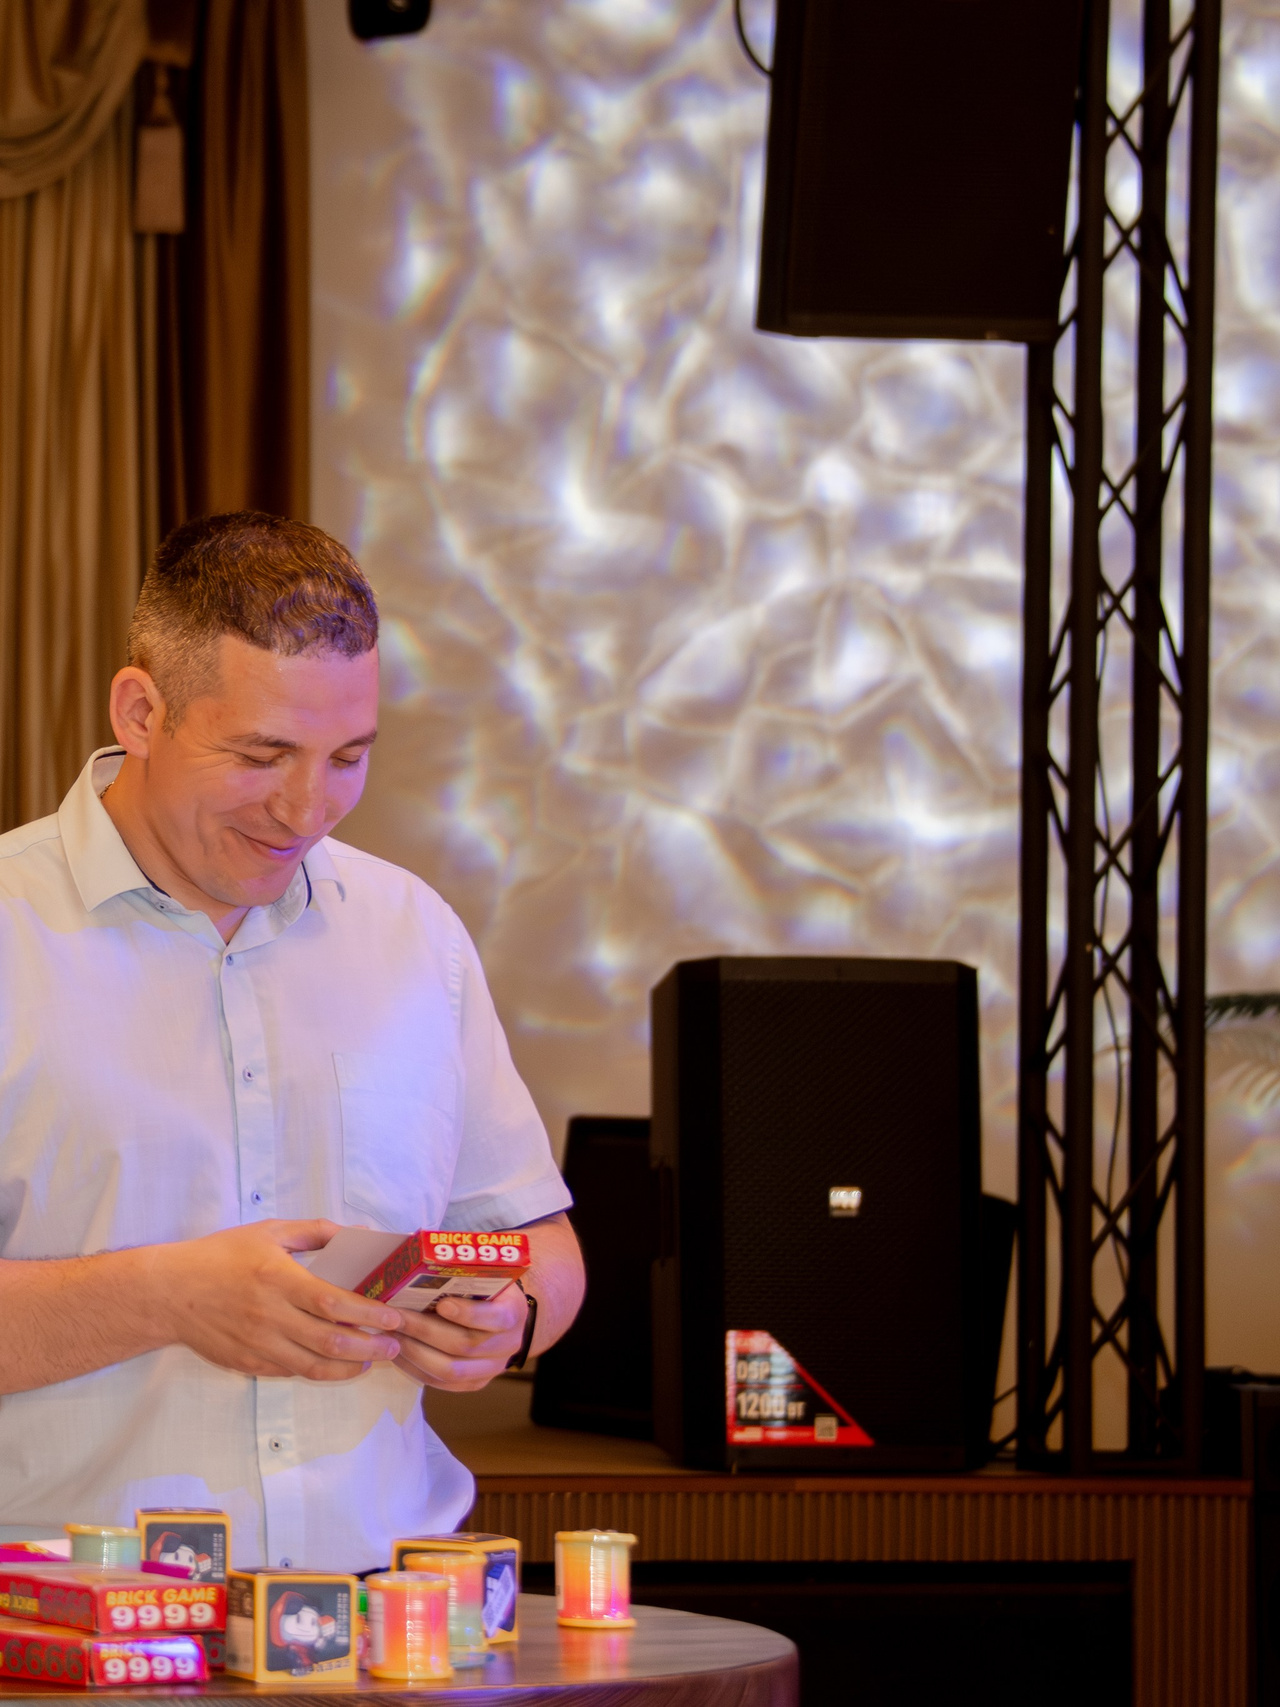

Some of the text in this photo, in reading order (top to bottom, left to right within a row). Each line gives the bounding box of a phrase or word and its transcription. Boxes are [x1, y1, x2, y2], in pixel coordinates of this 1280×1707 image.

[429, 1232, 522, 1246] BRICK GAME
[433, 1244, 521, 1262] 9999
[736, 1391, 786, 1421] 1200
[106, 1587, 218, 1606] BRICK GAME
[110, 1602, 215, 1629] 9999
[104, 1655, 198, 1682] 9999
